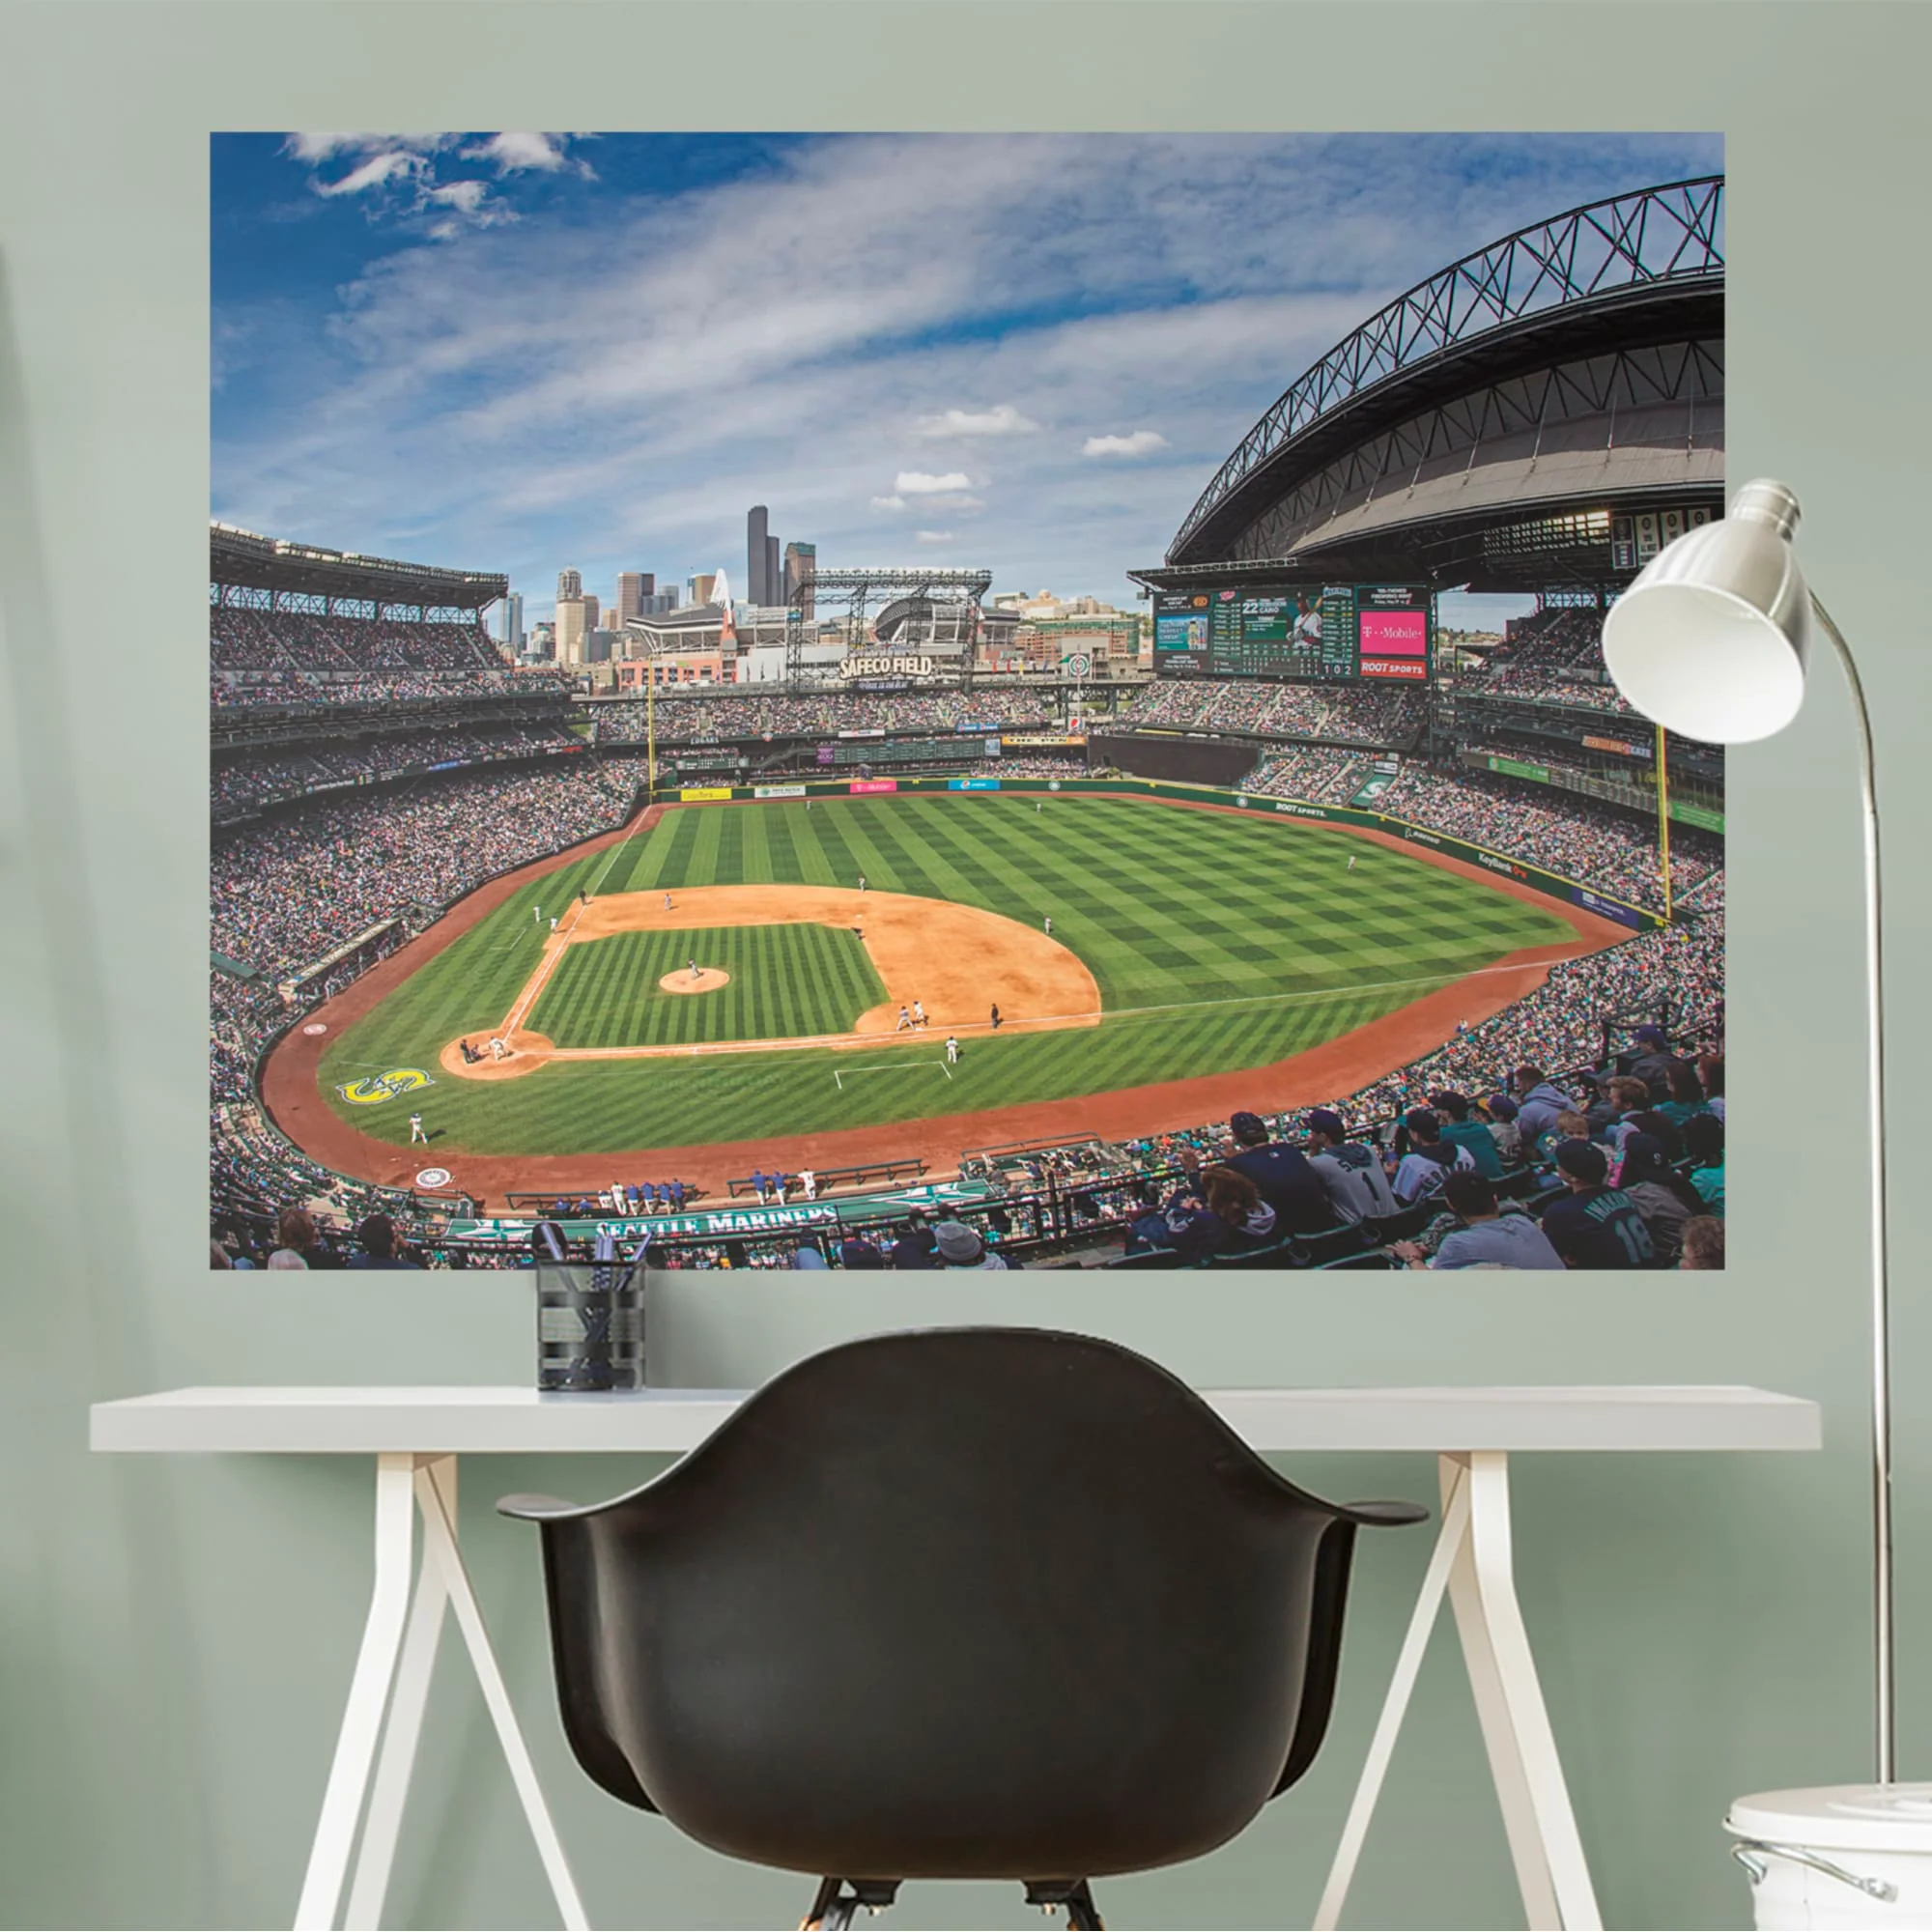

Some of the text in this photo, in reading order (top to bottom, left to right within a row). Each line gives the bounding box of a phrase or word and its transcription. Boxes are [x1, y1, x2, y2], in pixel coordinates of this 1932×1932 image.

[1242, 602, 1259, 614] 22
[839, 656, 932, 680] SAFECO FIELD
[1361, 663, 1387, 672] ROOT
[1276, 802, 1297, 812] ROOT
[596, 1206, 838, 1238] SEATTLE MARINERS
[1616, 1214, 1655, 1264] 18
